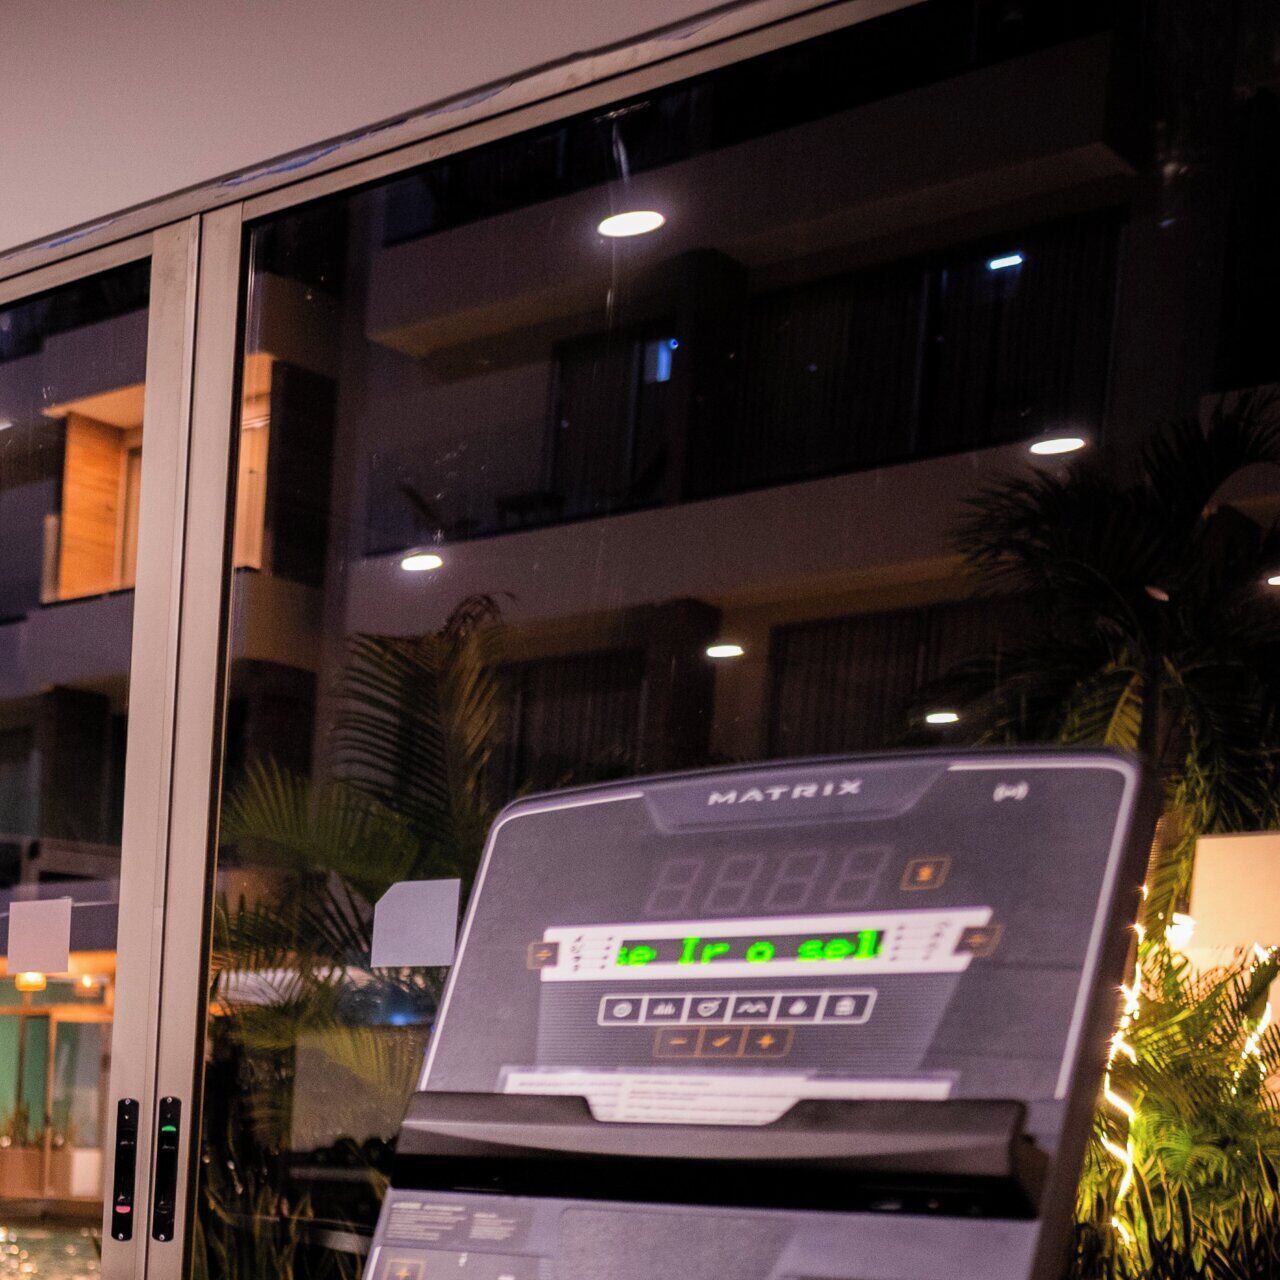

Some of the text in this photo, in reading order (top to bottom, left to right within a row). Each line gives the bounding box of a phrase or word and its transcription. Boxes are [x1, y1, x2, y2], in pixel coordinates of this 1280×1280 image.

[707, 778, 863, 806] MATRIX
[744, 941, 776, 963] o
[796, 929, 884, 963] sel
